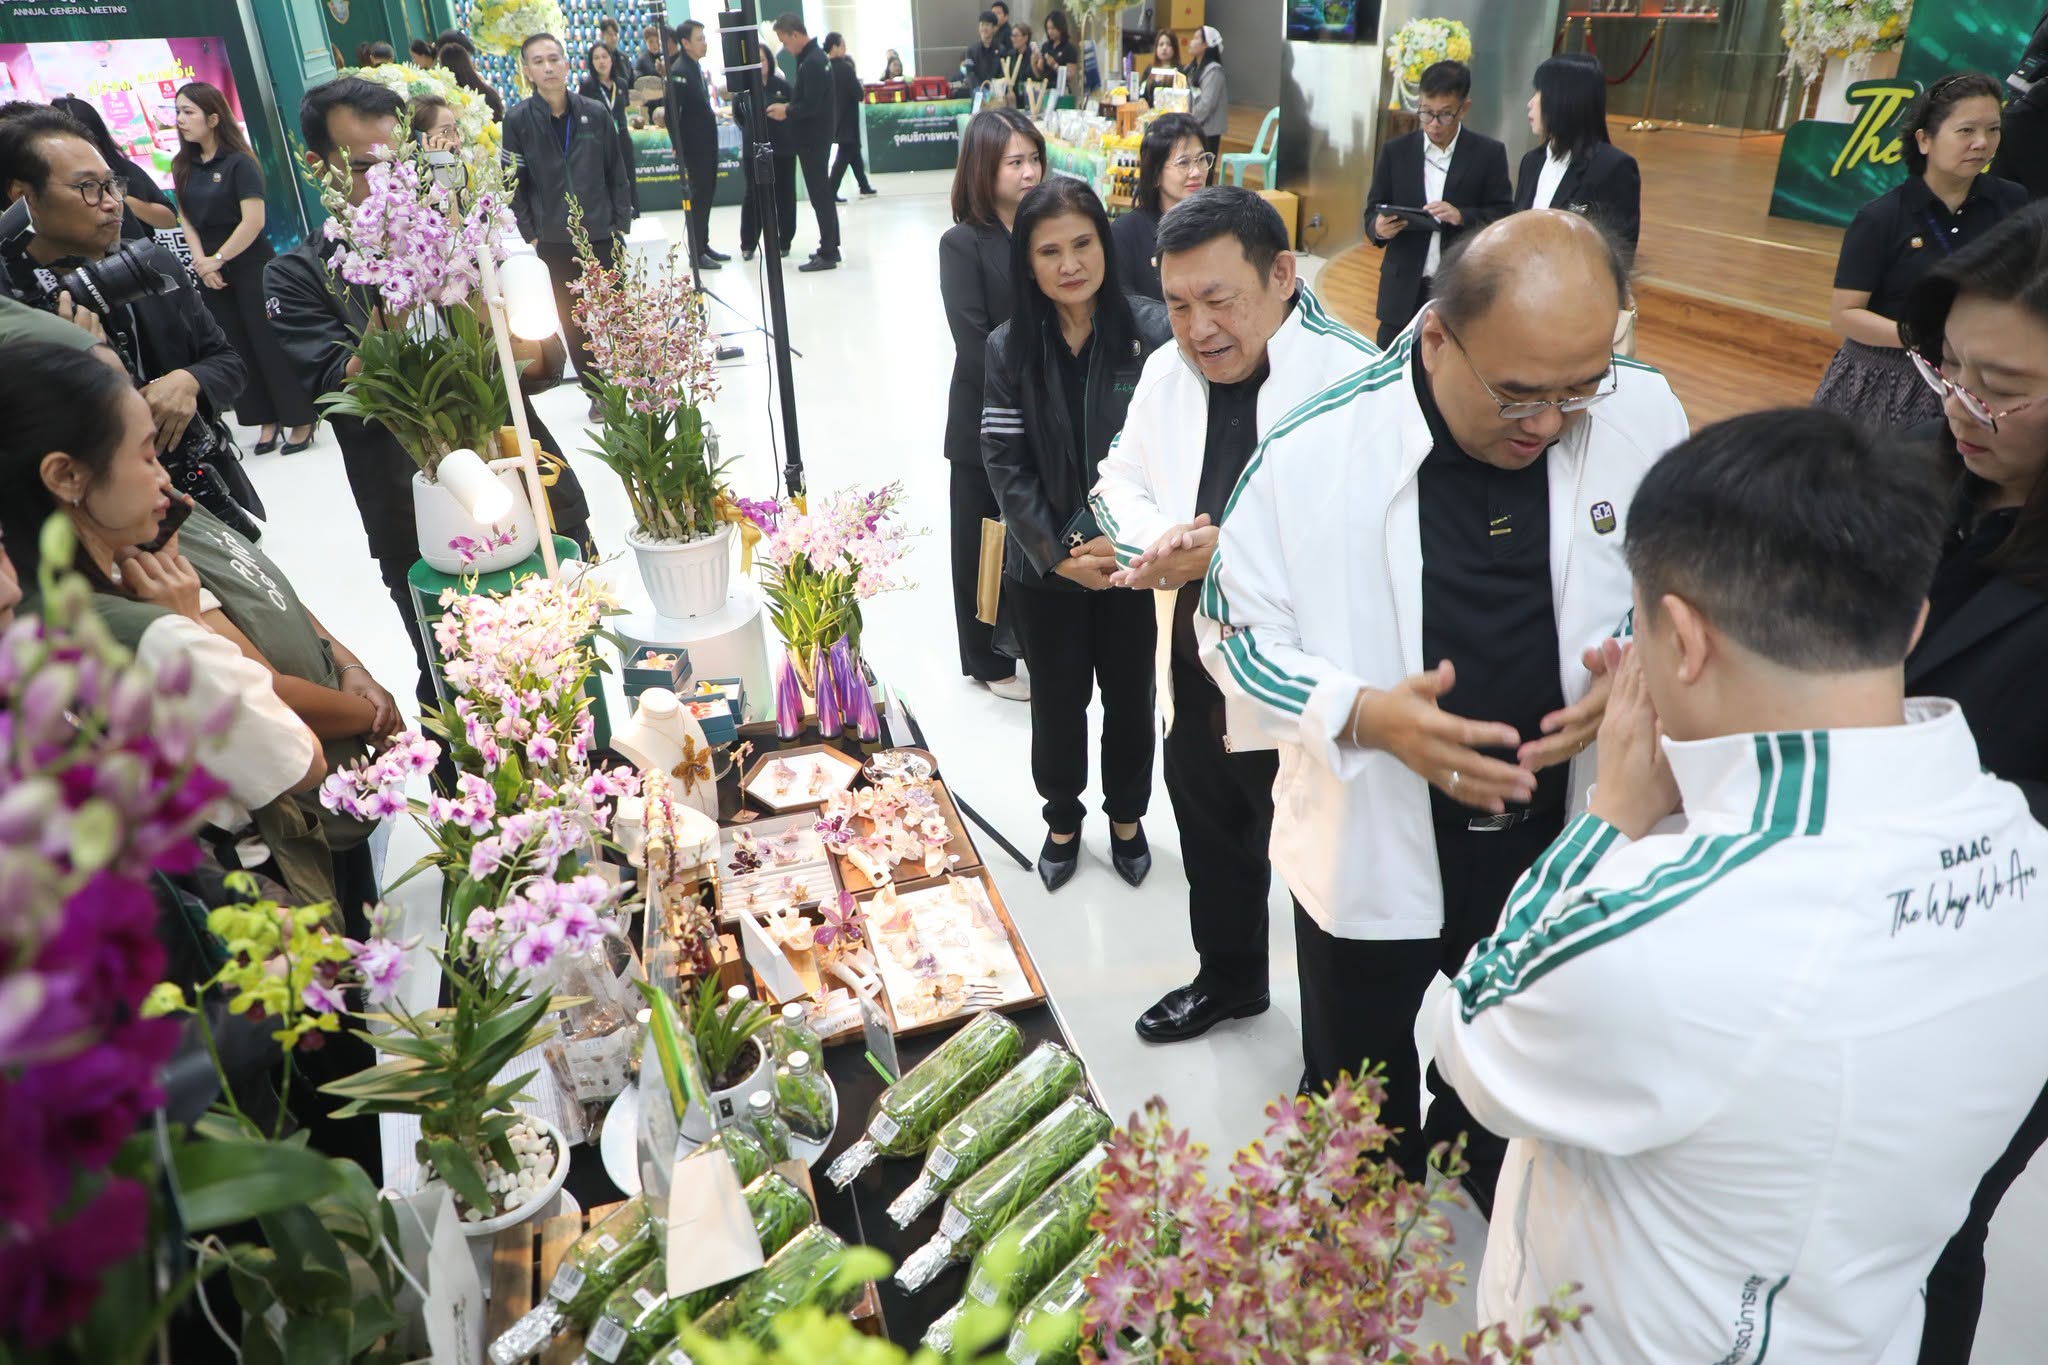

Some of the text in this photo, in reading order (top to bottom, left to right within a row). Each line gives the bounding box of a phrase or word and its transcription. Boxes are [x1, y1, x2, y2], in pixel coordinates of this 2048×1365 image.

[13, 6, 127, 16] ANNUAL GENERAL MEETING
[1940, 836, 1992, 870] BAAC
[1886, 888, 1922, 939] The
[1927, 882, 1971, 931] Way
[1976, 864, 2005, 910] We
